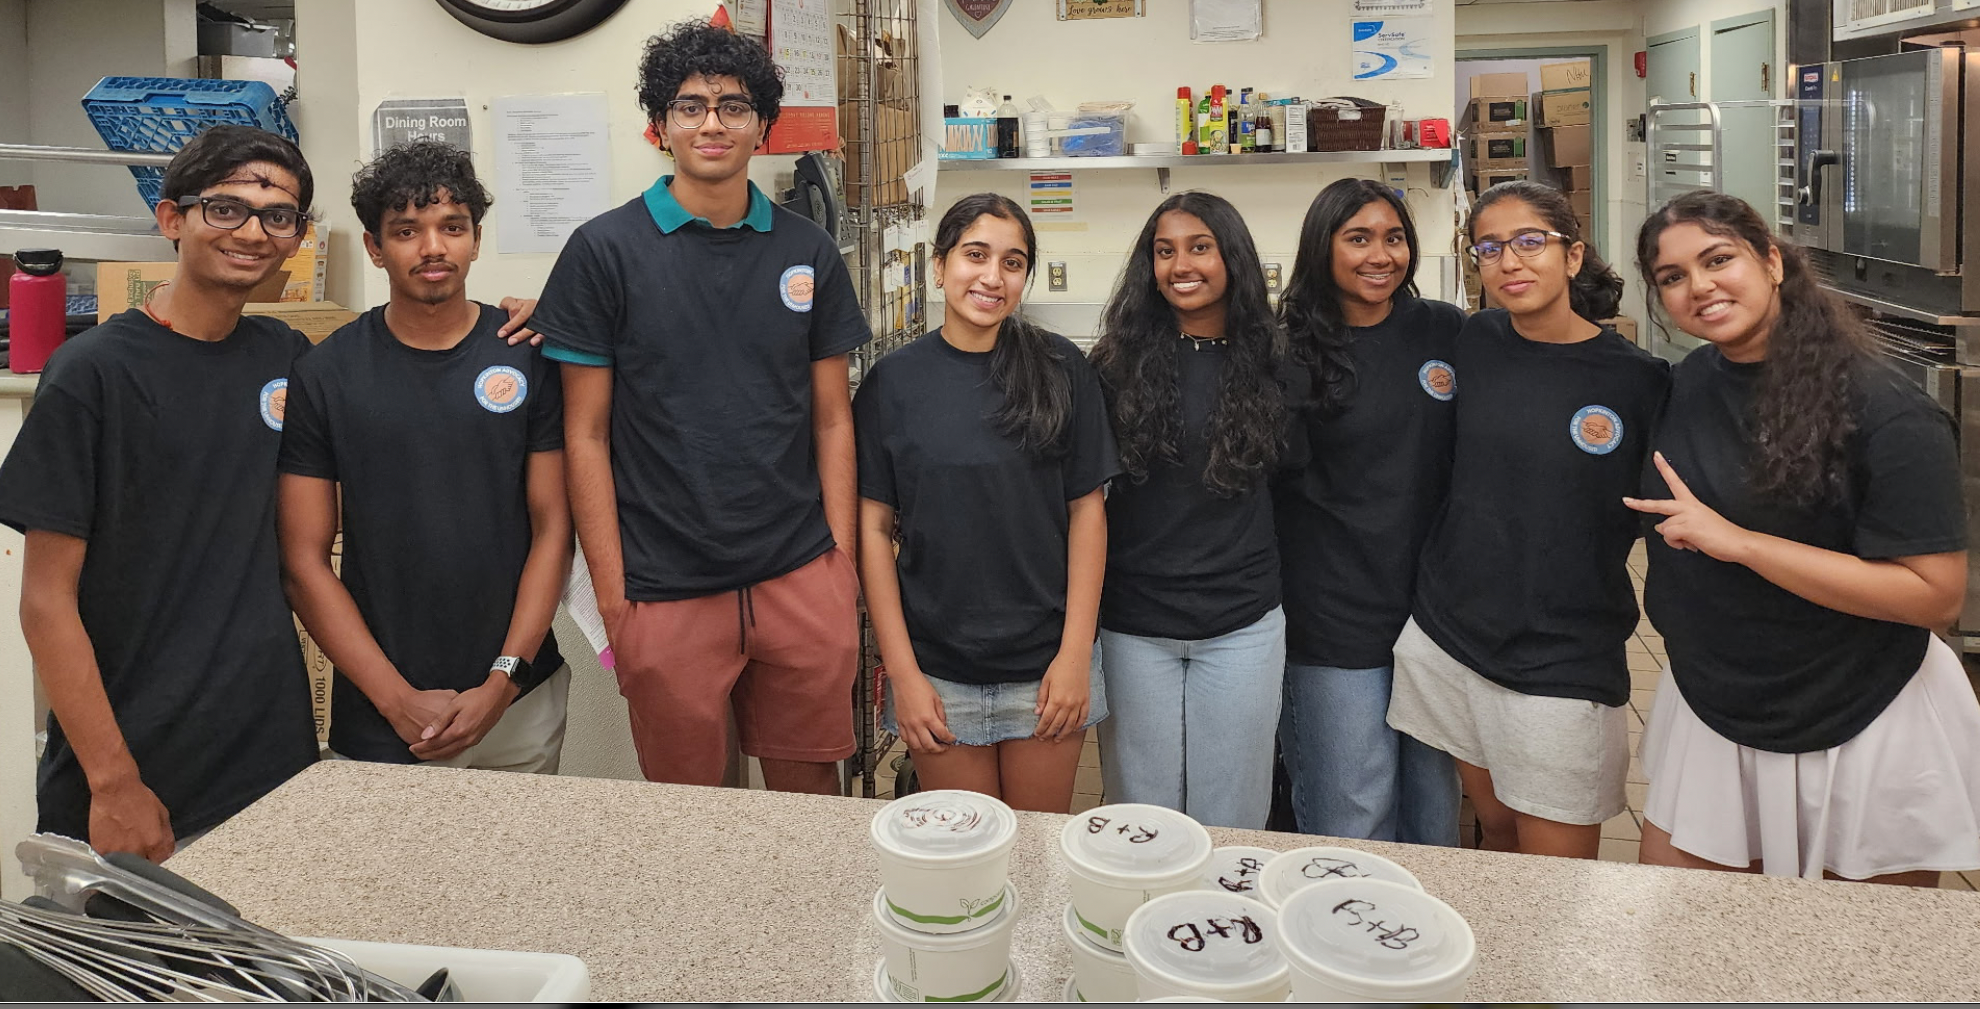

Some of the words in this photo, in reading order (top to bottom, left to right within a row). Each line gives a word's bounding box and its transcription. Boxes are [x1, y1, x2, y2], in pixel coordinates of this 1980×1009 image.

[1067, 5, 1084, 16] Love
[1087, 6, 1113, 16] grows
[385, 116, 426, 130] Dining
[429, 116, 466, 128] Room
[315, 676, 326, 704] 1000
[314, 708, 325, 735] LIDS
